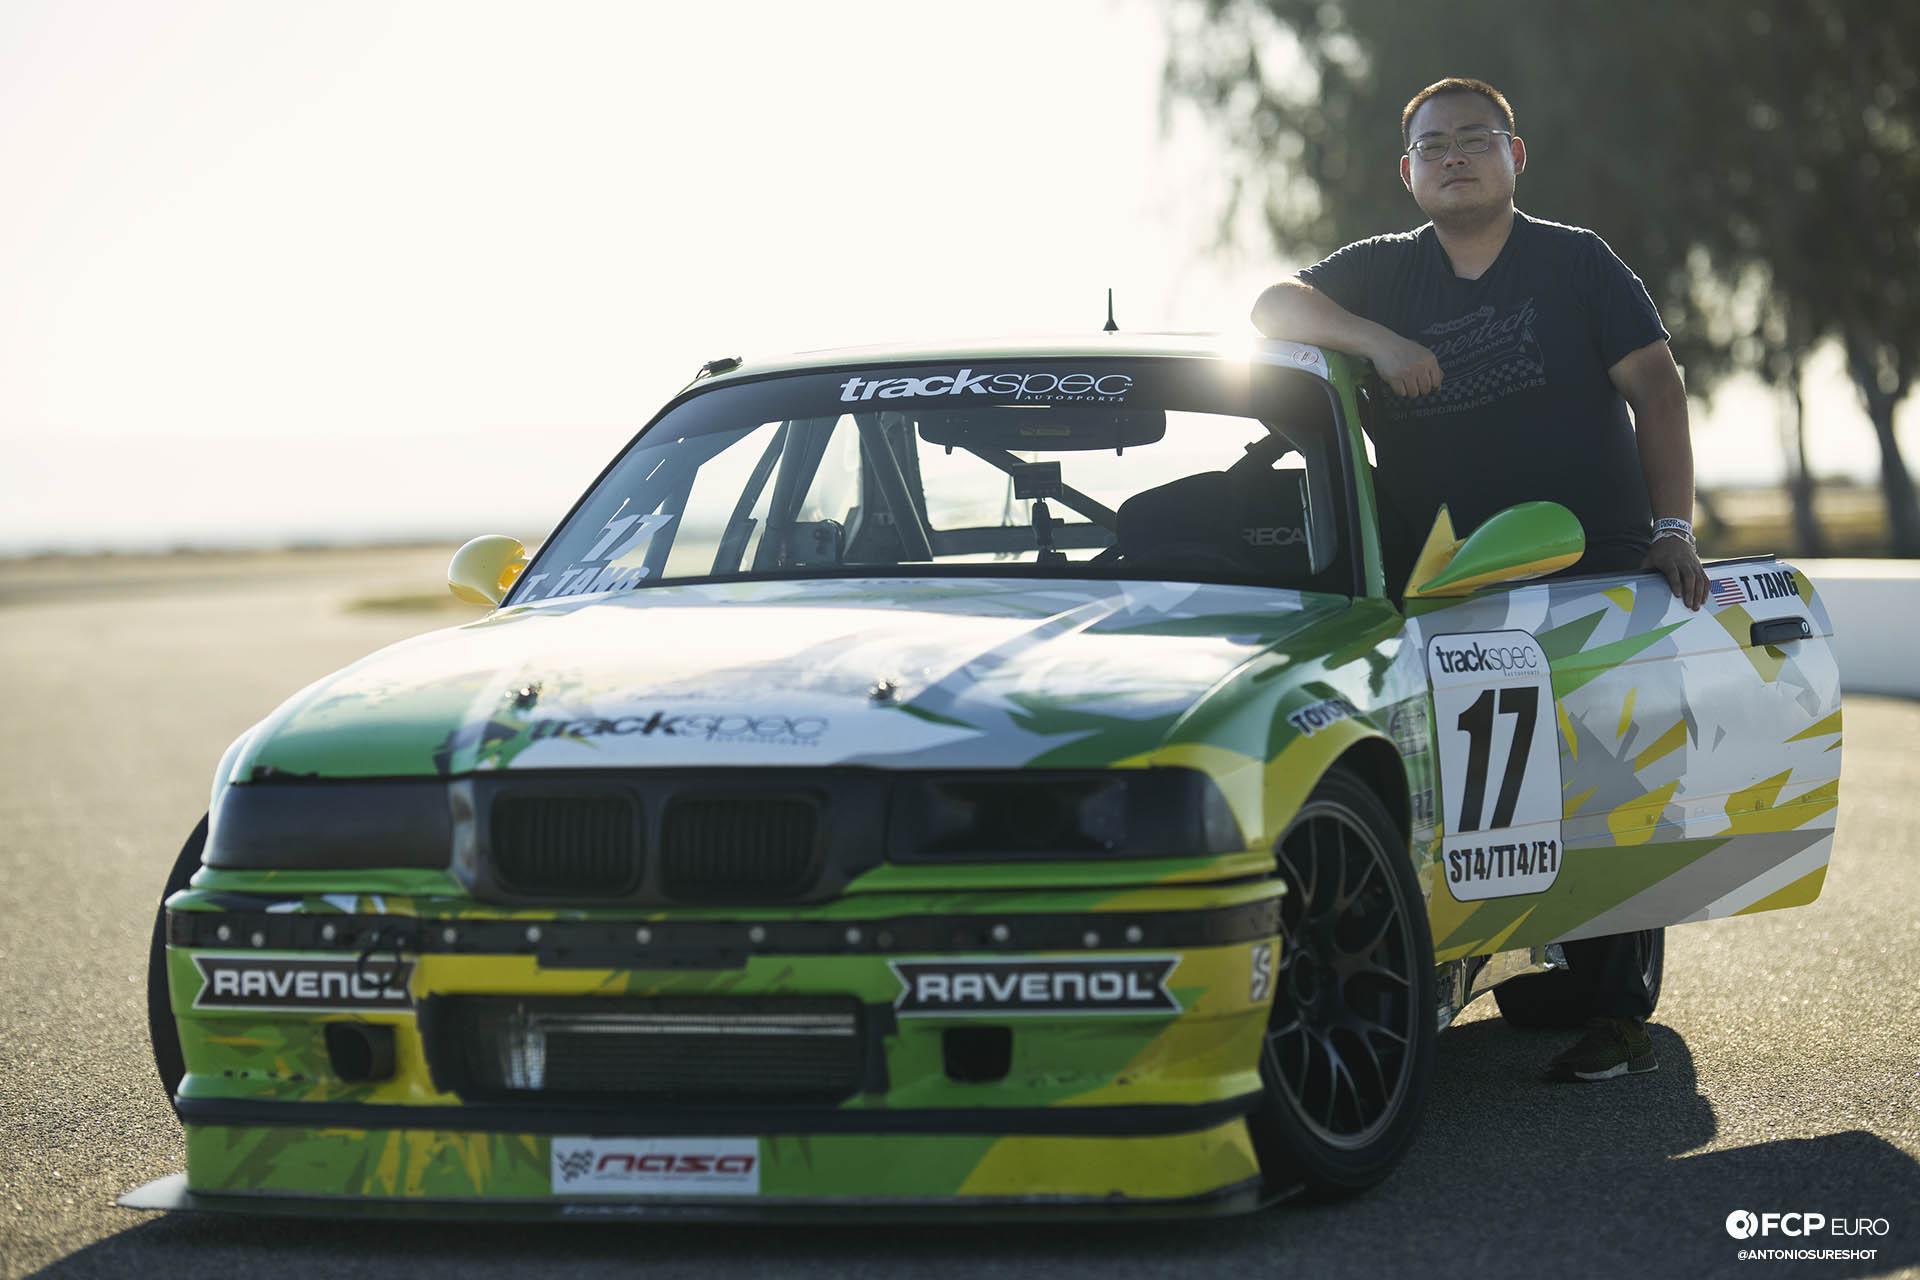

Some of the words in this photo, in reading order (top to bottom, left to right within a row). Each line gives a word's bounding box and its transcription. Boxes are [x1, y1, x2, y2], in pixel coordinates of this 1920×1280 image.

[840, 368, 1132, 401] trackspec
[1024, 394, 1125, 402] AUTOSPORTS
[580, 514, 674, 562] 17
[1739, 575, 1759, 601] T.
[1753, 570, 1800, 600] TANG
[1436, 642, 1538, 676] trackspec
[1457, 686, 1539, 833] 17
[1449, 840, 1557, 884] ST4/TT4/E1
[916, 971, 1155, 1001] RAVENOL
